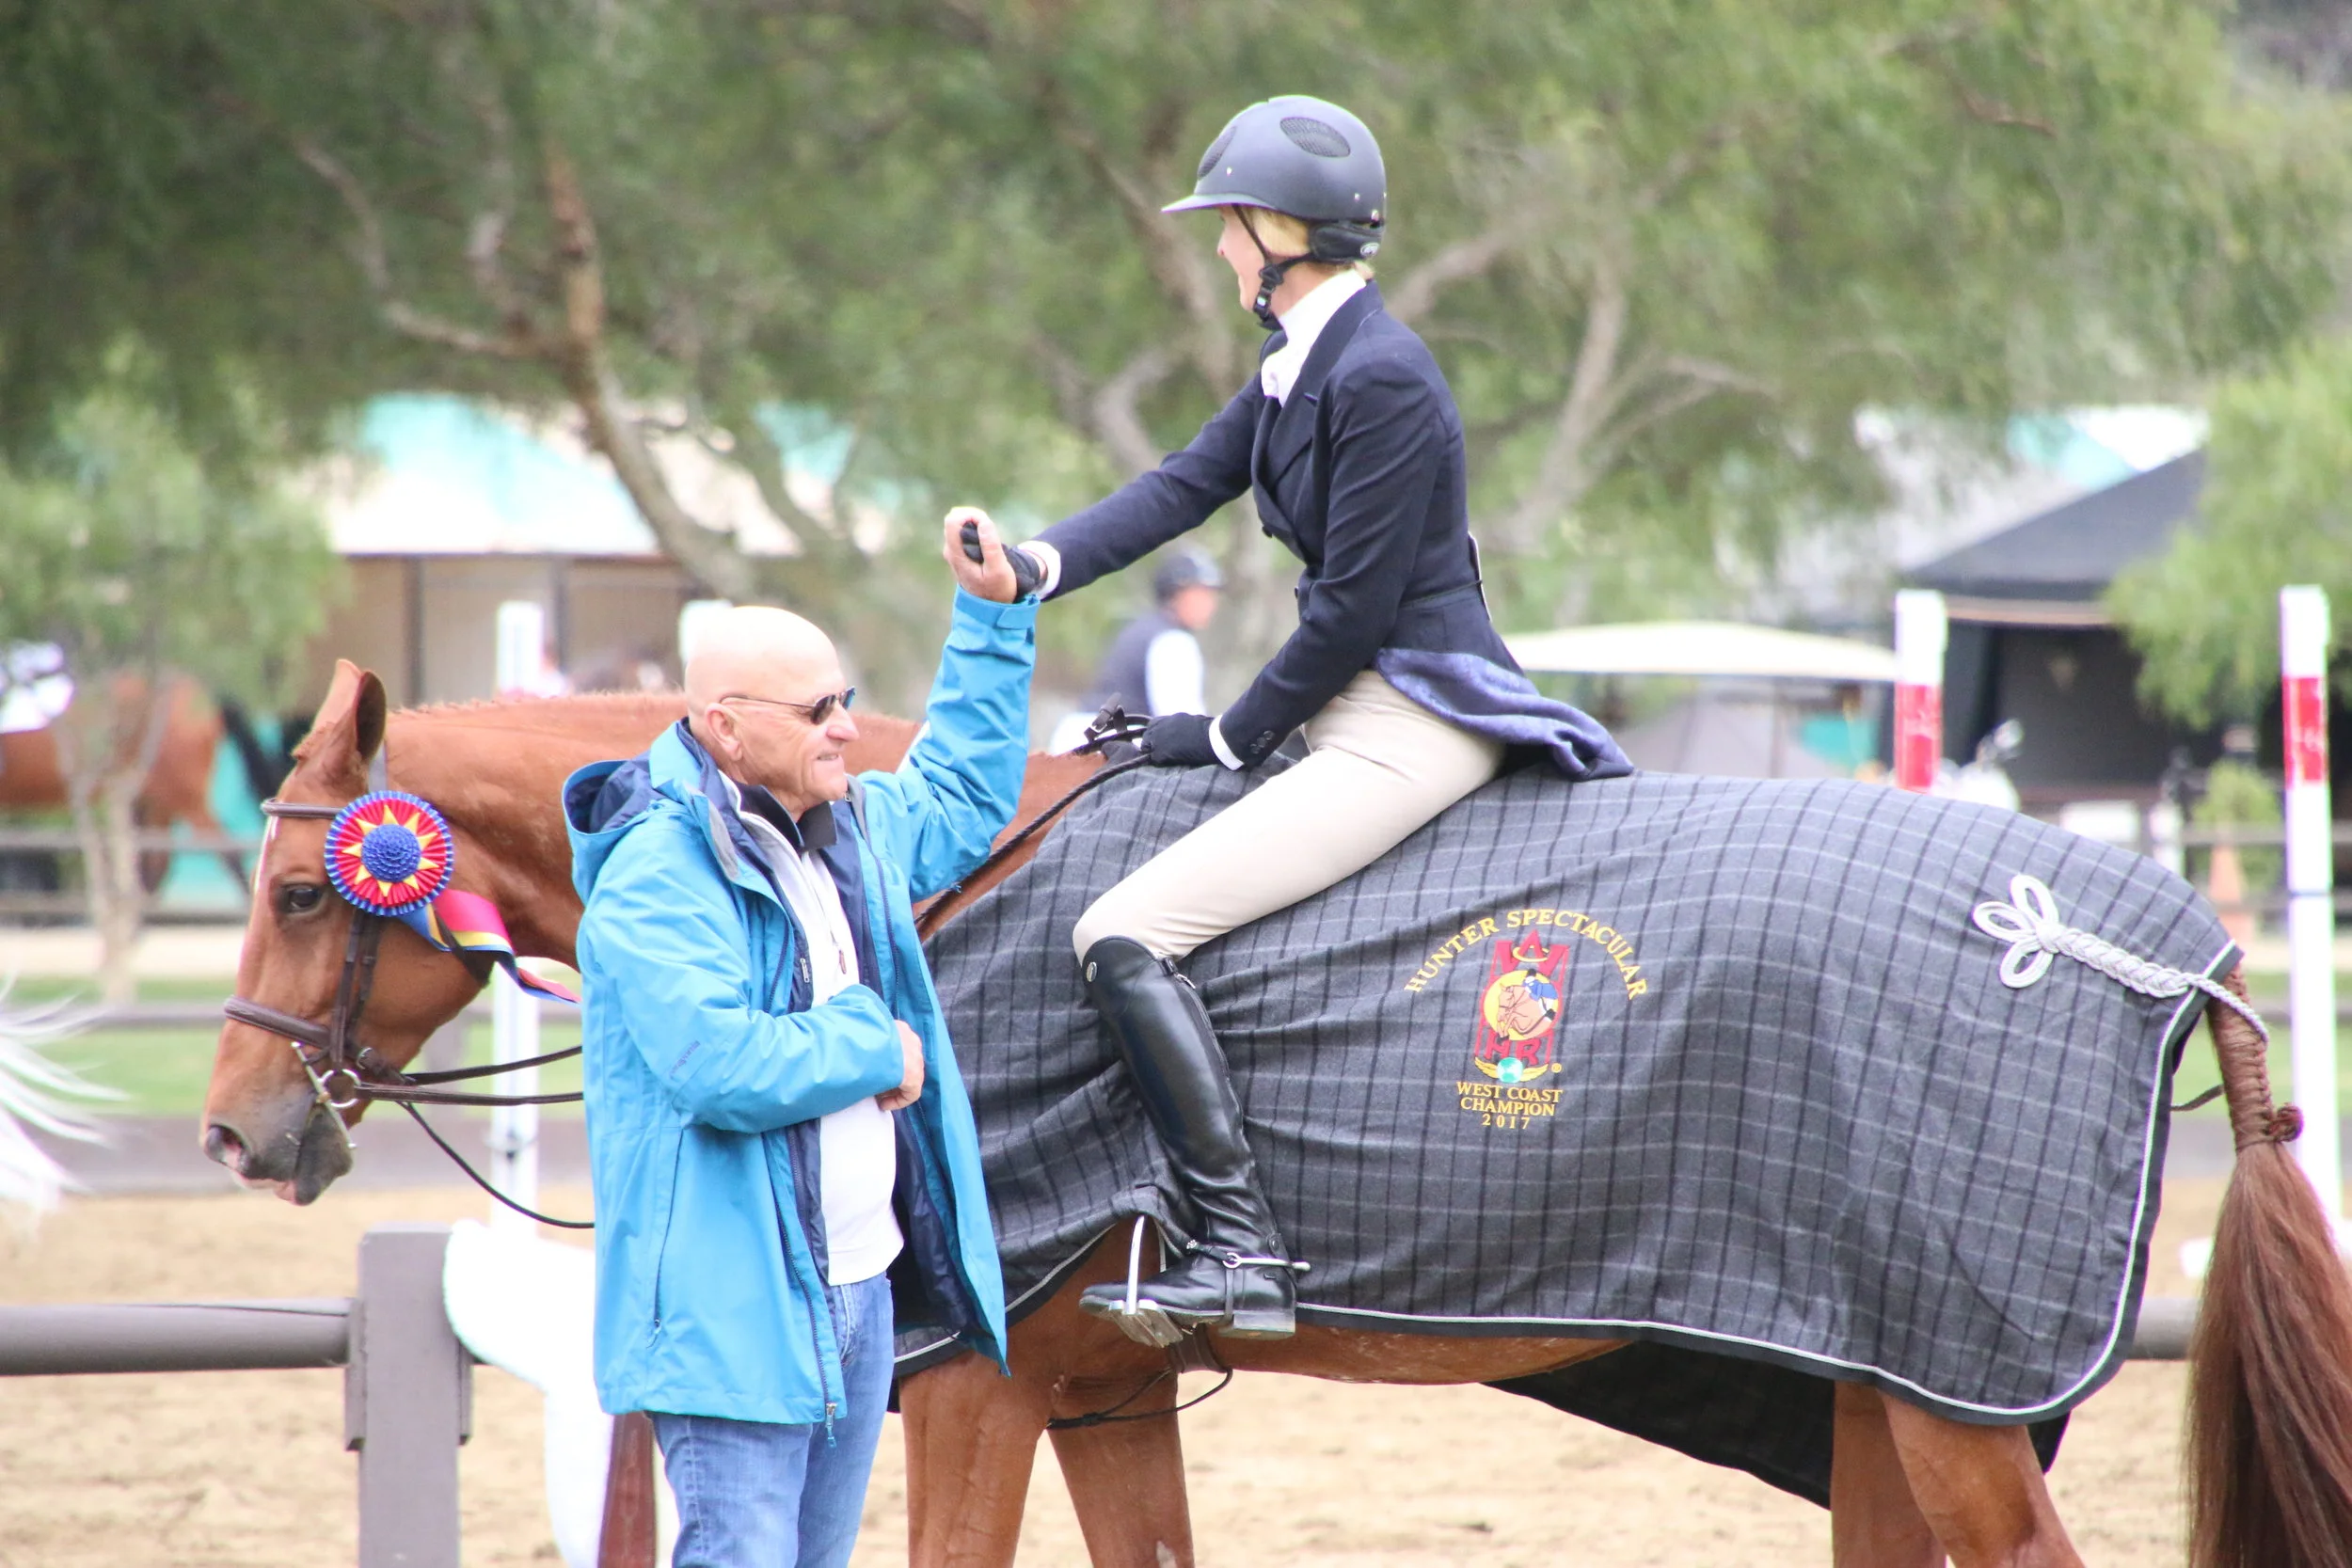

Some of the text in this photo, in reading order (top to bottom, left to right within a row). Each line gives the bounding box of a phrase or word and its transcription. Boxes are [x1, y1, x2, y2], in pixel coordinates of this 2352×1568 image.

[1405, 909, 1647, 1000] HUNTER SPECTACULAR
[1456, 1082, 1563, 1103] WEST COAST
[1460, 1097, 1555, 1117] CHAMPION
[1482, 1113, 1530, 1130] 2017
